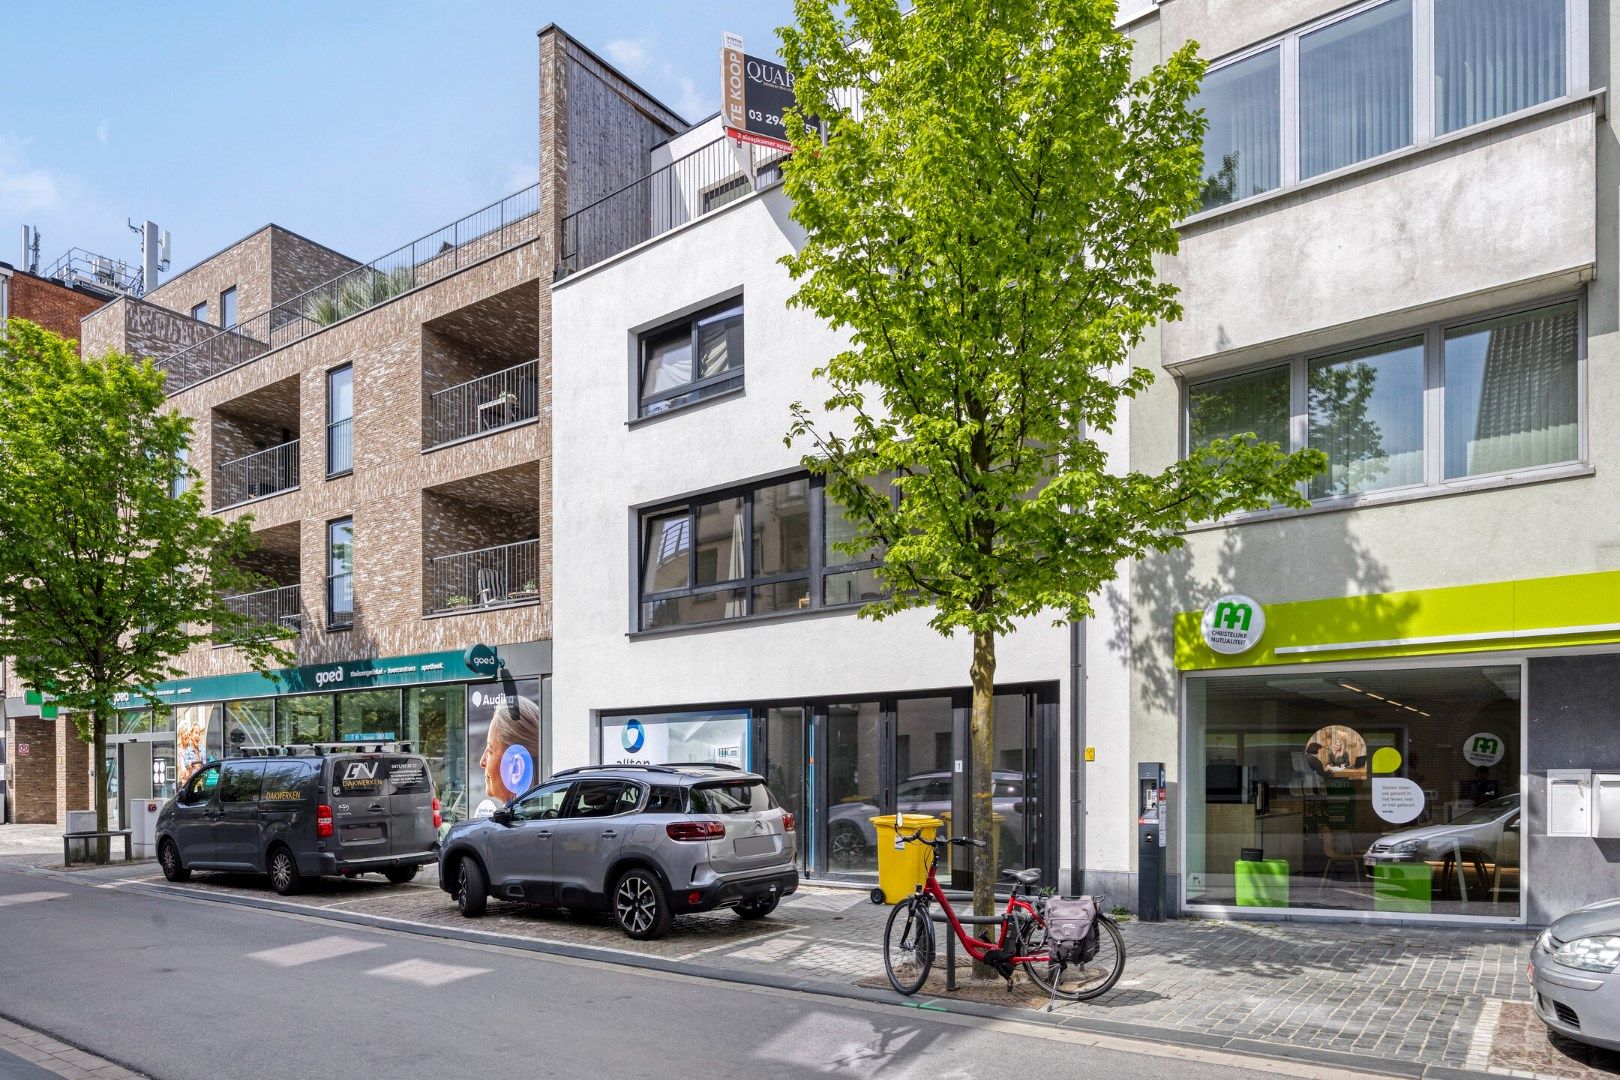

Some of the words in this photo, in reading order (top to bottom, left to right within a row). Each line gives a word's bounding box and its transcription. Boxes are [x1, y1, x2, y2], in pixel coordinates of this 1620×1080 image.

[730, 52, 742, 101] KOOP
[746, 61, 796, 88] QUAR
[730, 103, 742, 122] TE
[748, 109, 763, 122] 03
[1211, 630, 1248, 639] CHRISTELIJKE
[1210, 637, 1247, 646] MUTUALITEIT
[473, 656, 495, 667] goed
[315, 666, 344, 687] goed
[342, 779, 384, 788] DAKWERKEN
[265, 790, 301, 801] DAKWERKEN
